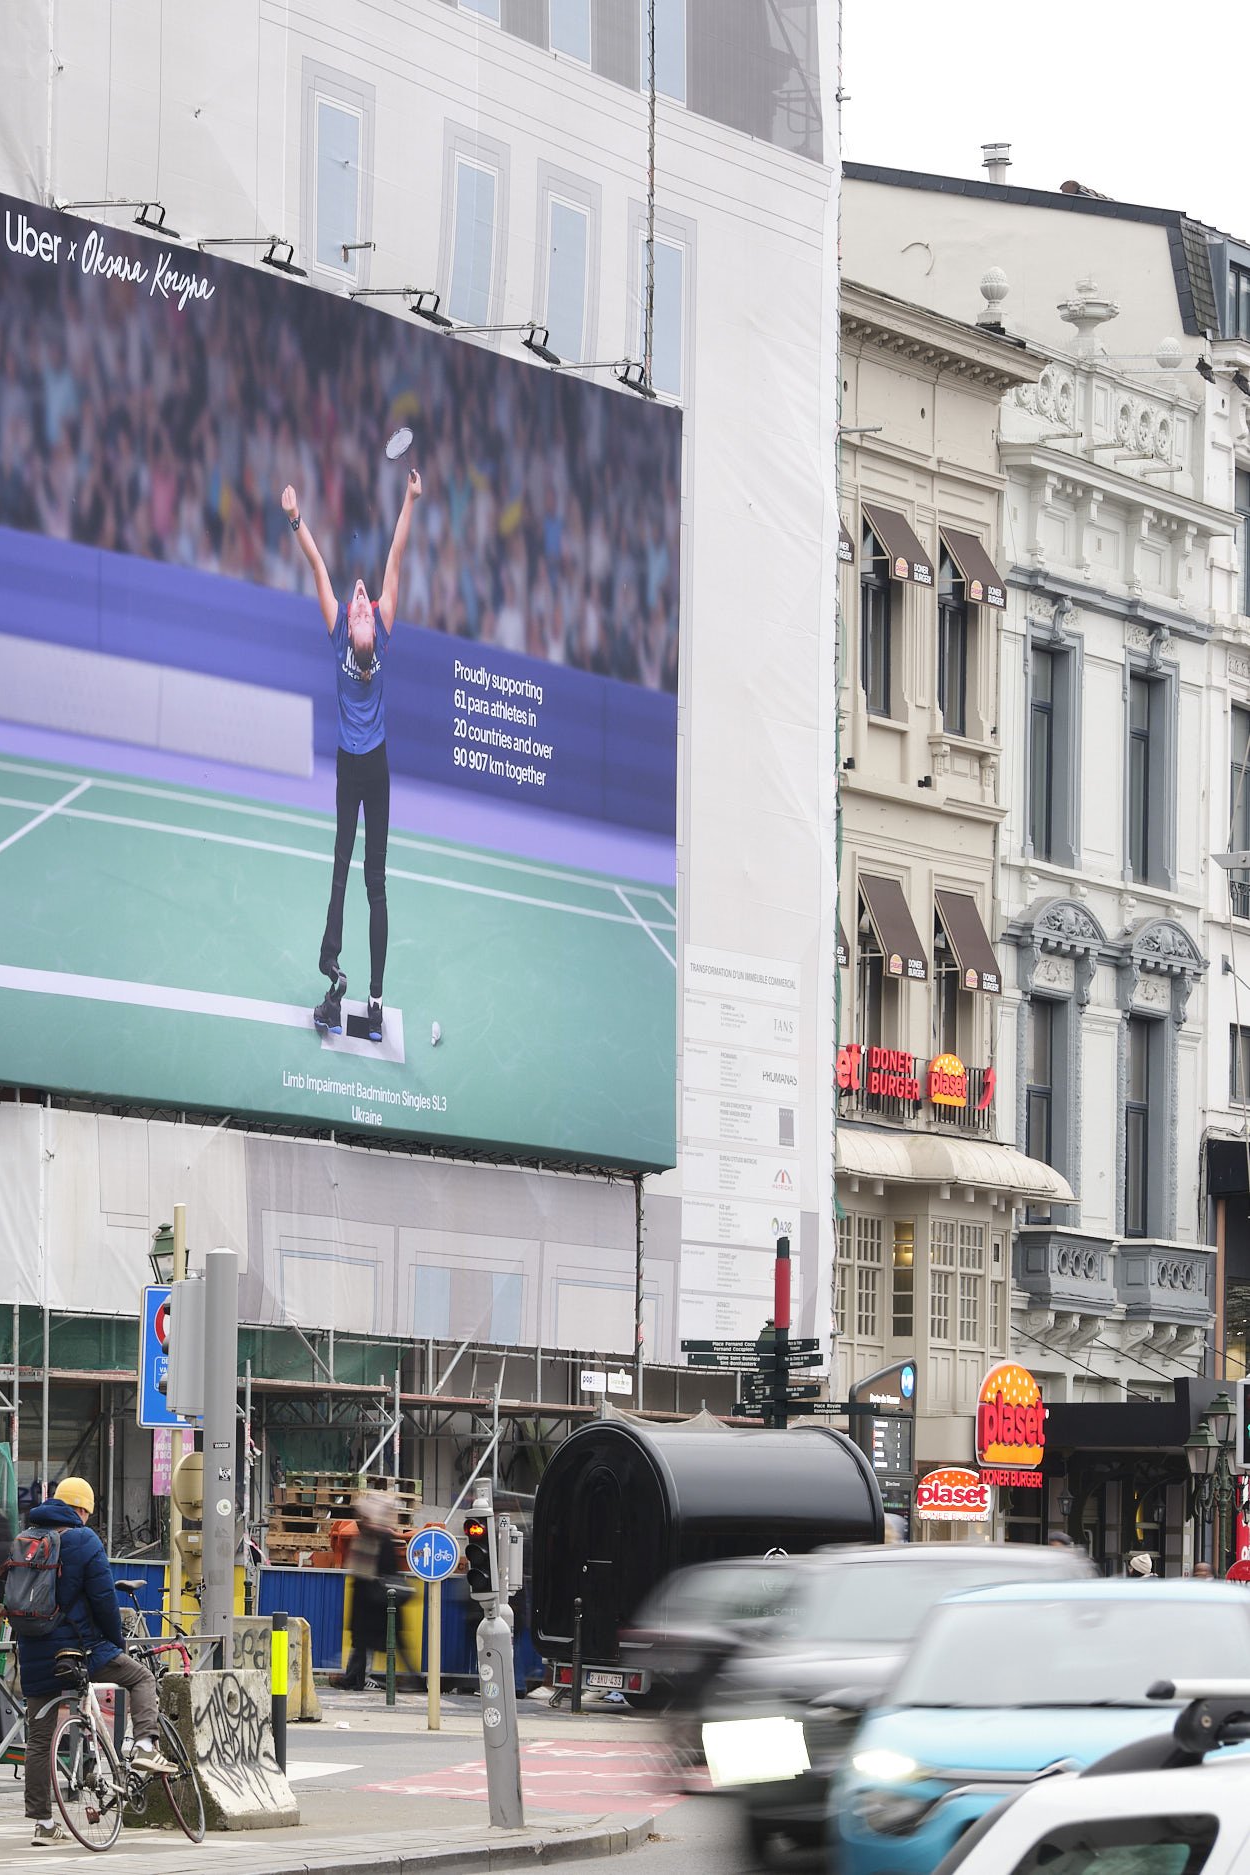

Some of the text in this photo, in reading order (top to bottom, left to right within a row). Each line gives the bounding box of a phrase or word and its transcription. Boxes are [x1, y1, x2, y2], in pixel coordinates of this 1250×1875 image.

[5, 210, 62, 264] Uber
[81, 230, 149, 283] Oksana
[454, 659, 543, 705] Proudly supporting
[454, 688, 537, 727] 61 para athletes in
[453, 717, 553, 760] 20 countries and over
[453, 747, 546, 786] 90 907 km together
[690, 962, 732, 978] TRANSFORMATION
[773, 1018, 794, 1034] TANS
[869, 1046, 913, 1074] DONER
[282, 1070, 447, 1112] Limb Impairment Badminton Singles SL3
[869, 1072, 920, 1100] BURGER
[930, 1067, 967, 1099] plaset
[351, 1105, 382, 1126] Ukraine
[982, 1390, 1046, 1454] plaset
[917, 1482, 989, 1506] plaset
[981, 1470, 1043, 1488] DONER BURGER!
